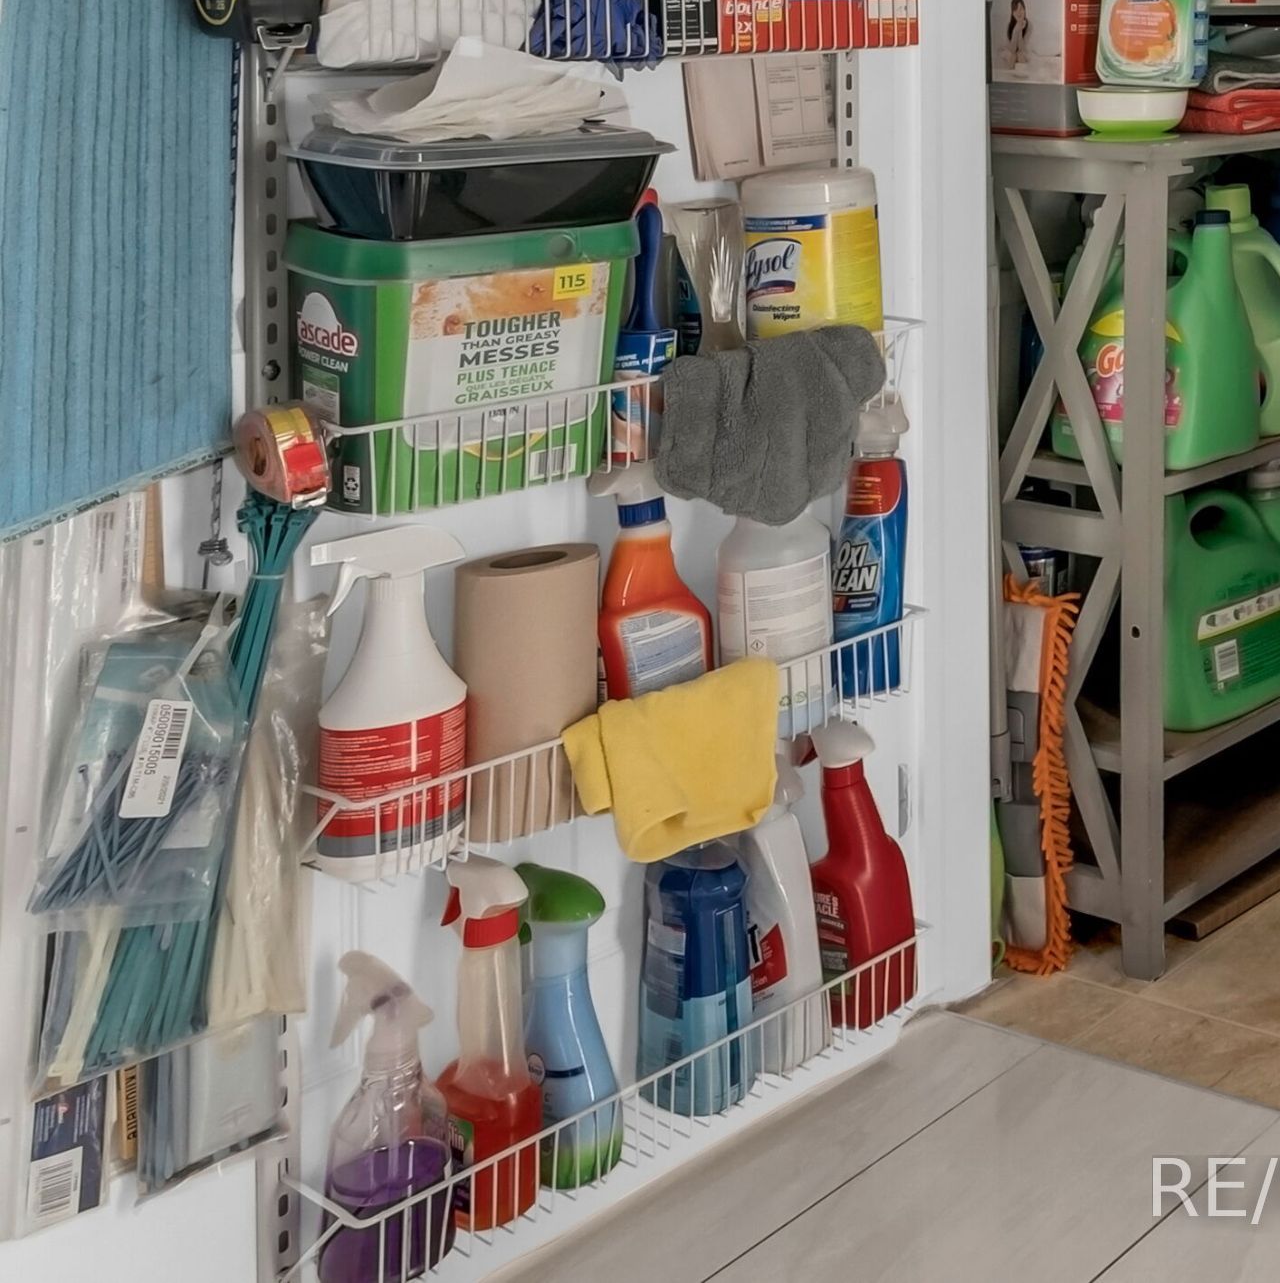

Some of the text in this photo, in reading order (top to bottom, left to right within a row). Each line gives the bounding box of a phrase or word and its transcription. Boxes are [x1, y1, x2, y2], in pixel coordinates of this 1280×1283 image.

[559, 273, 585, 290] 115
[752, 303, 801, 313] Disinfecting
[773, 311, 801, 321] Wipes
[299, 320, 356, 354] ascade
[463, 311, 561, 340] TOUGHER
[461, 329, 561, 351] THAN GREASY
[321, 355, 349, 373] CLEAN
[459, 340, 560, 368] MESSES
[457, 359, 556, 385] PLUS TENACE
[455, 380, 554, 406] GRAISSEUX
[465, 379, 508, 394] QUE LES
[836, 541, 868, 571] OXI
[832, 566, 877, 591] LEAN
